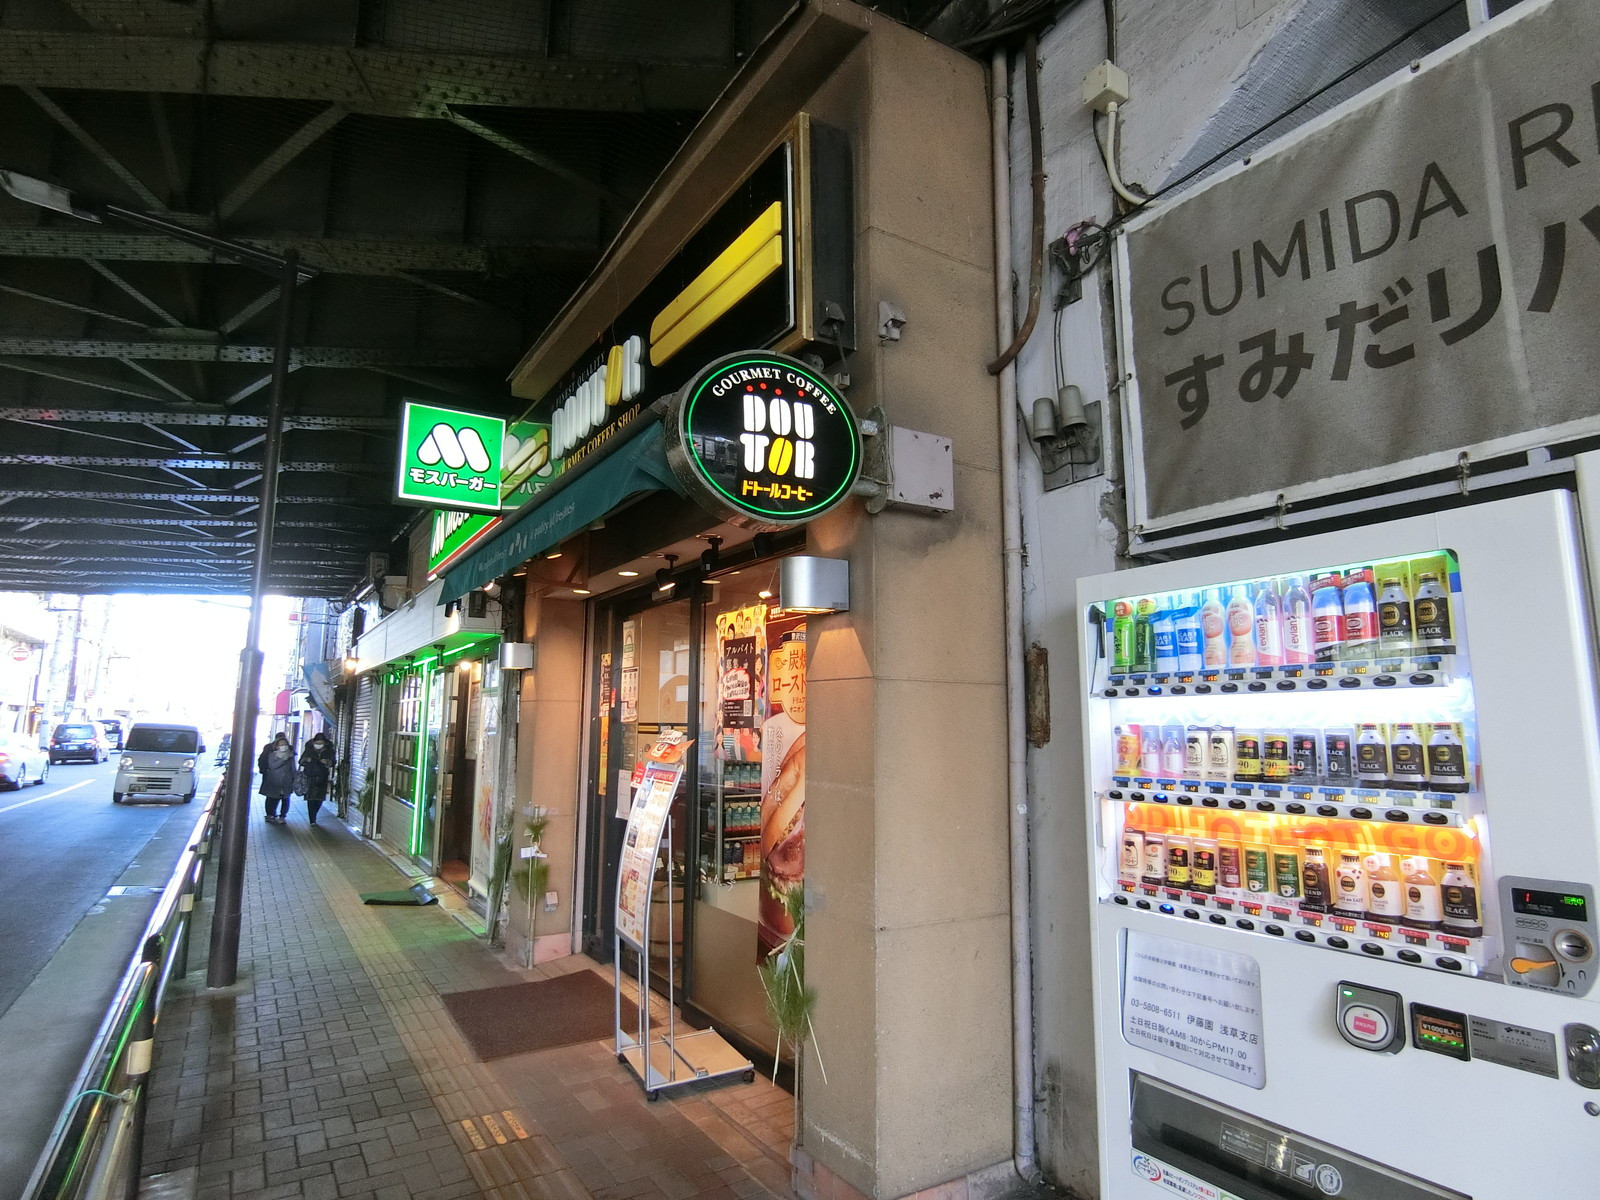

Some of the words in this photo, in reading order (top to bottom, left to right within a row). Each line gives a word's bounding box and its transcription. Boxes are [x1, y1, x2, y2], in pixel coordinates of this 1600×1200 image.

[1160, 161, 1468, 337] SUMIDA
[712, 367, 782, 397] GOURMET
[786, 372, 837, 416] COFFEE
[588, 424, 616, 455] COFFEE
[617, 403, 641, 430] SHOP
[408, 466, 497, 492] モスバーガー
[741, 479, 814, 502] ドトールコーヒー
[1259, 622, 1267, 647] evian
[1290, 619, 1299, 645] evian
[725, 642, 754, 656] アルバイト
[1130, 998, 1181, 1021] 03-5808-6511
[1186, 1014, 1214, 1032] 伊藤園
[1219, 1024, 1259, 1046] 浅草支店
